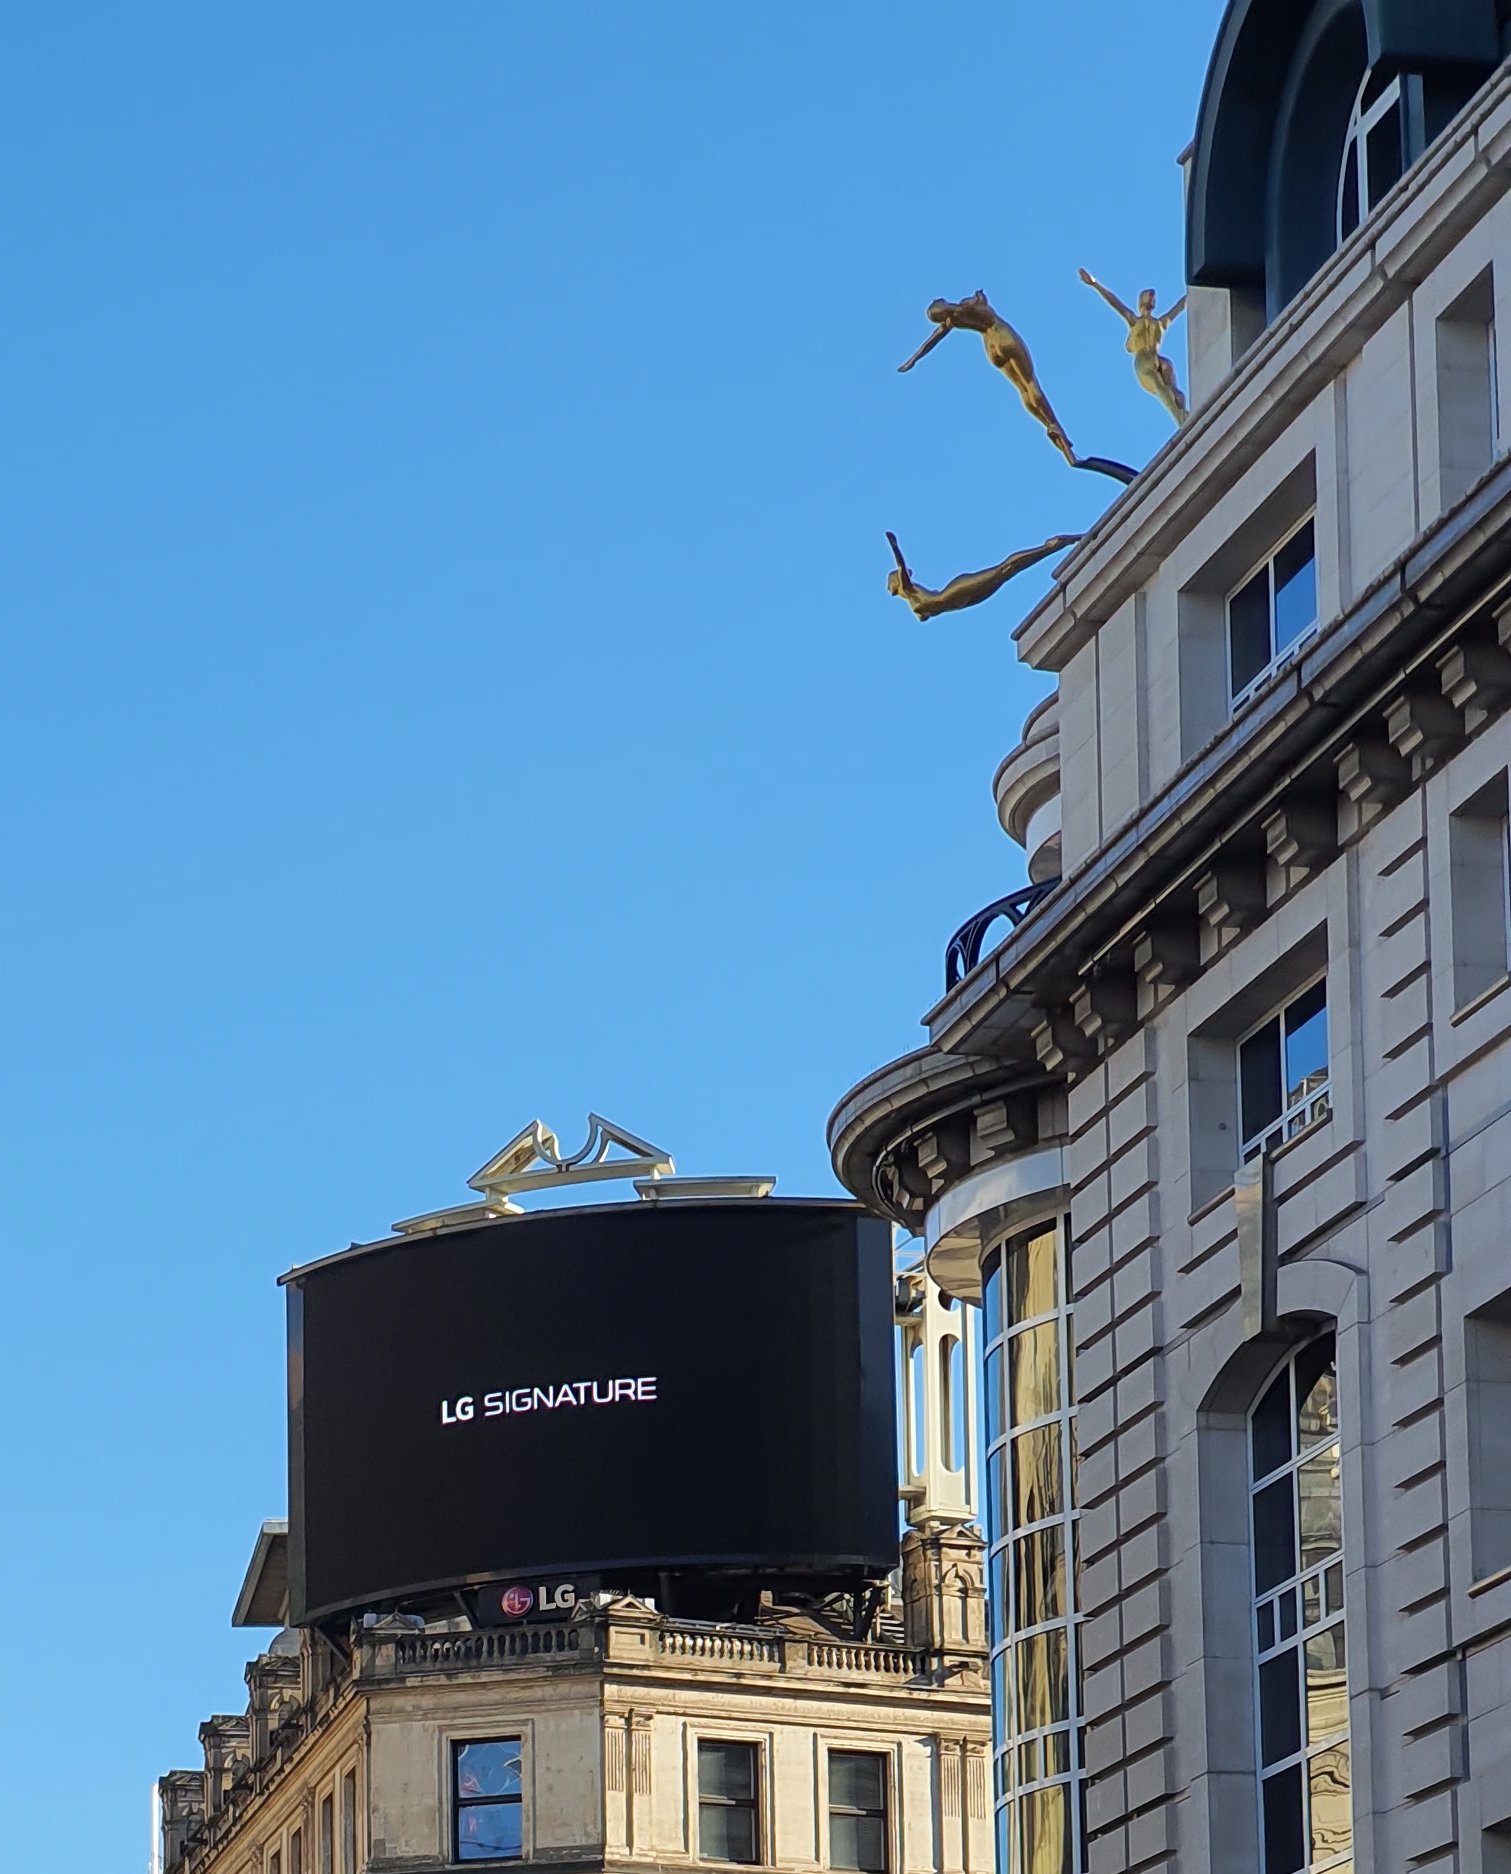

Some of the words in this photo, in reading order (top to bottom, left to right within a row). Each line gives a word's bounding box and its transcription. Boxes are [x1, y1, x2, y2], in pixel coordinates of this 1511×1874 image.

[441, 1396, 474, 1424] LG
[484, 1376, 658, 1417] SIGNATURE
[538, 1583, 575, 1611] LG
